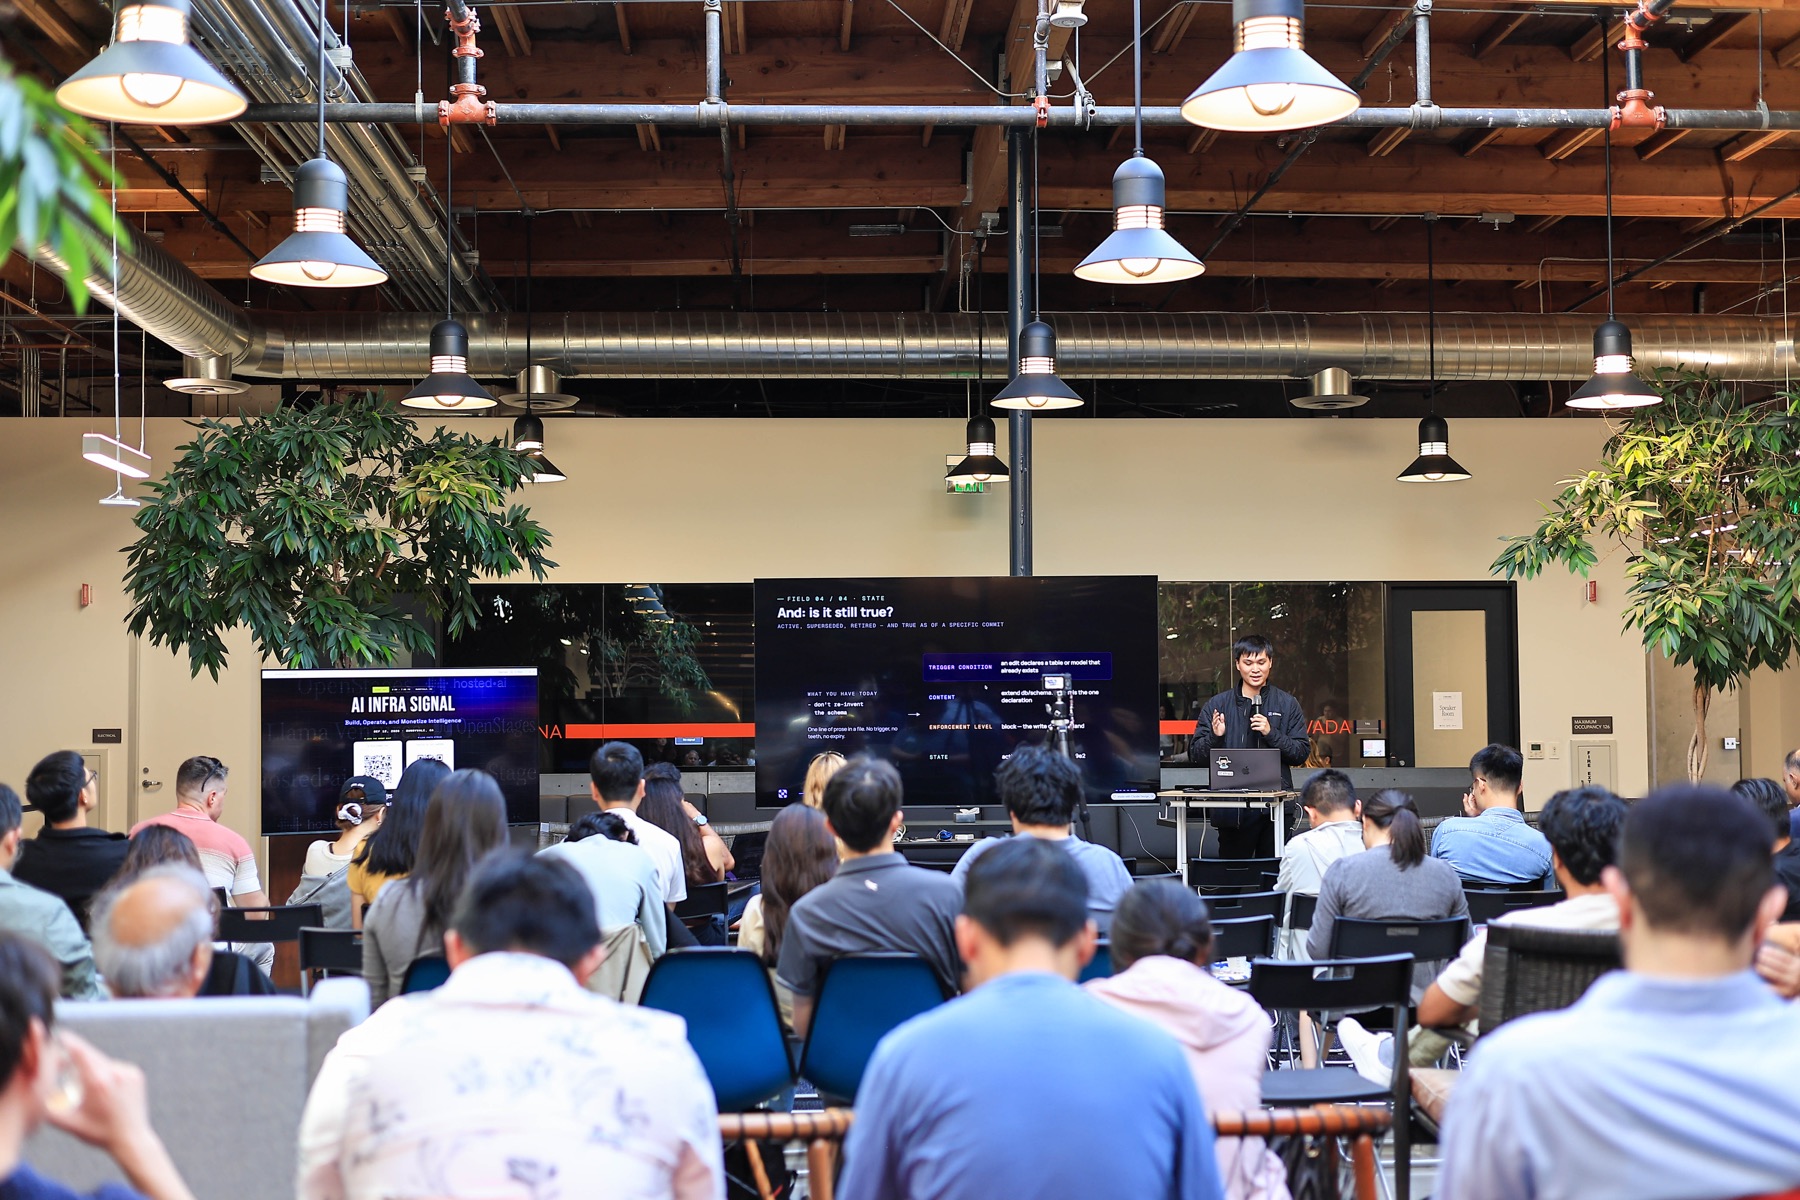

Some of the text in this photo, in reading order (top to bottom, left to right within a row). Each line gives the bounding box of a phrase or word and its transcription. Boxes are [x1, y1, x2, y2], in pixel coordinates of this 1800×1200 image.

[777, 606, 894, 618] And: is it still true?
[351, 695, 455, 712] AI INFRA SIGNAL
[457, 716, 536, 738] OpenStages
